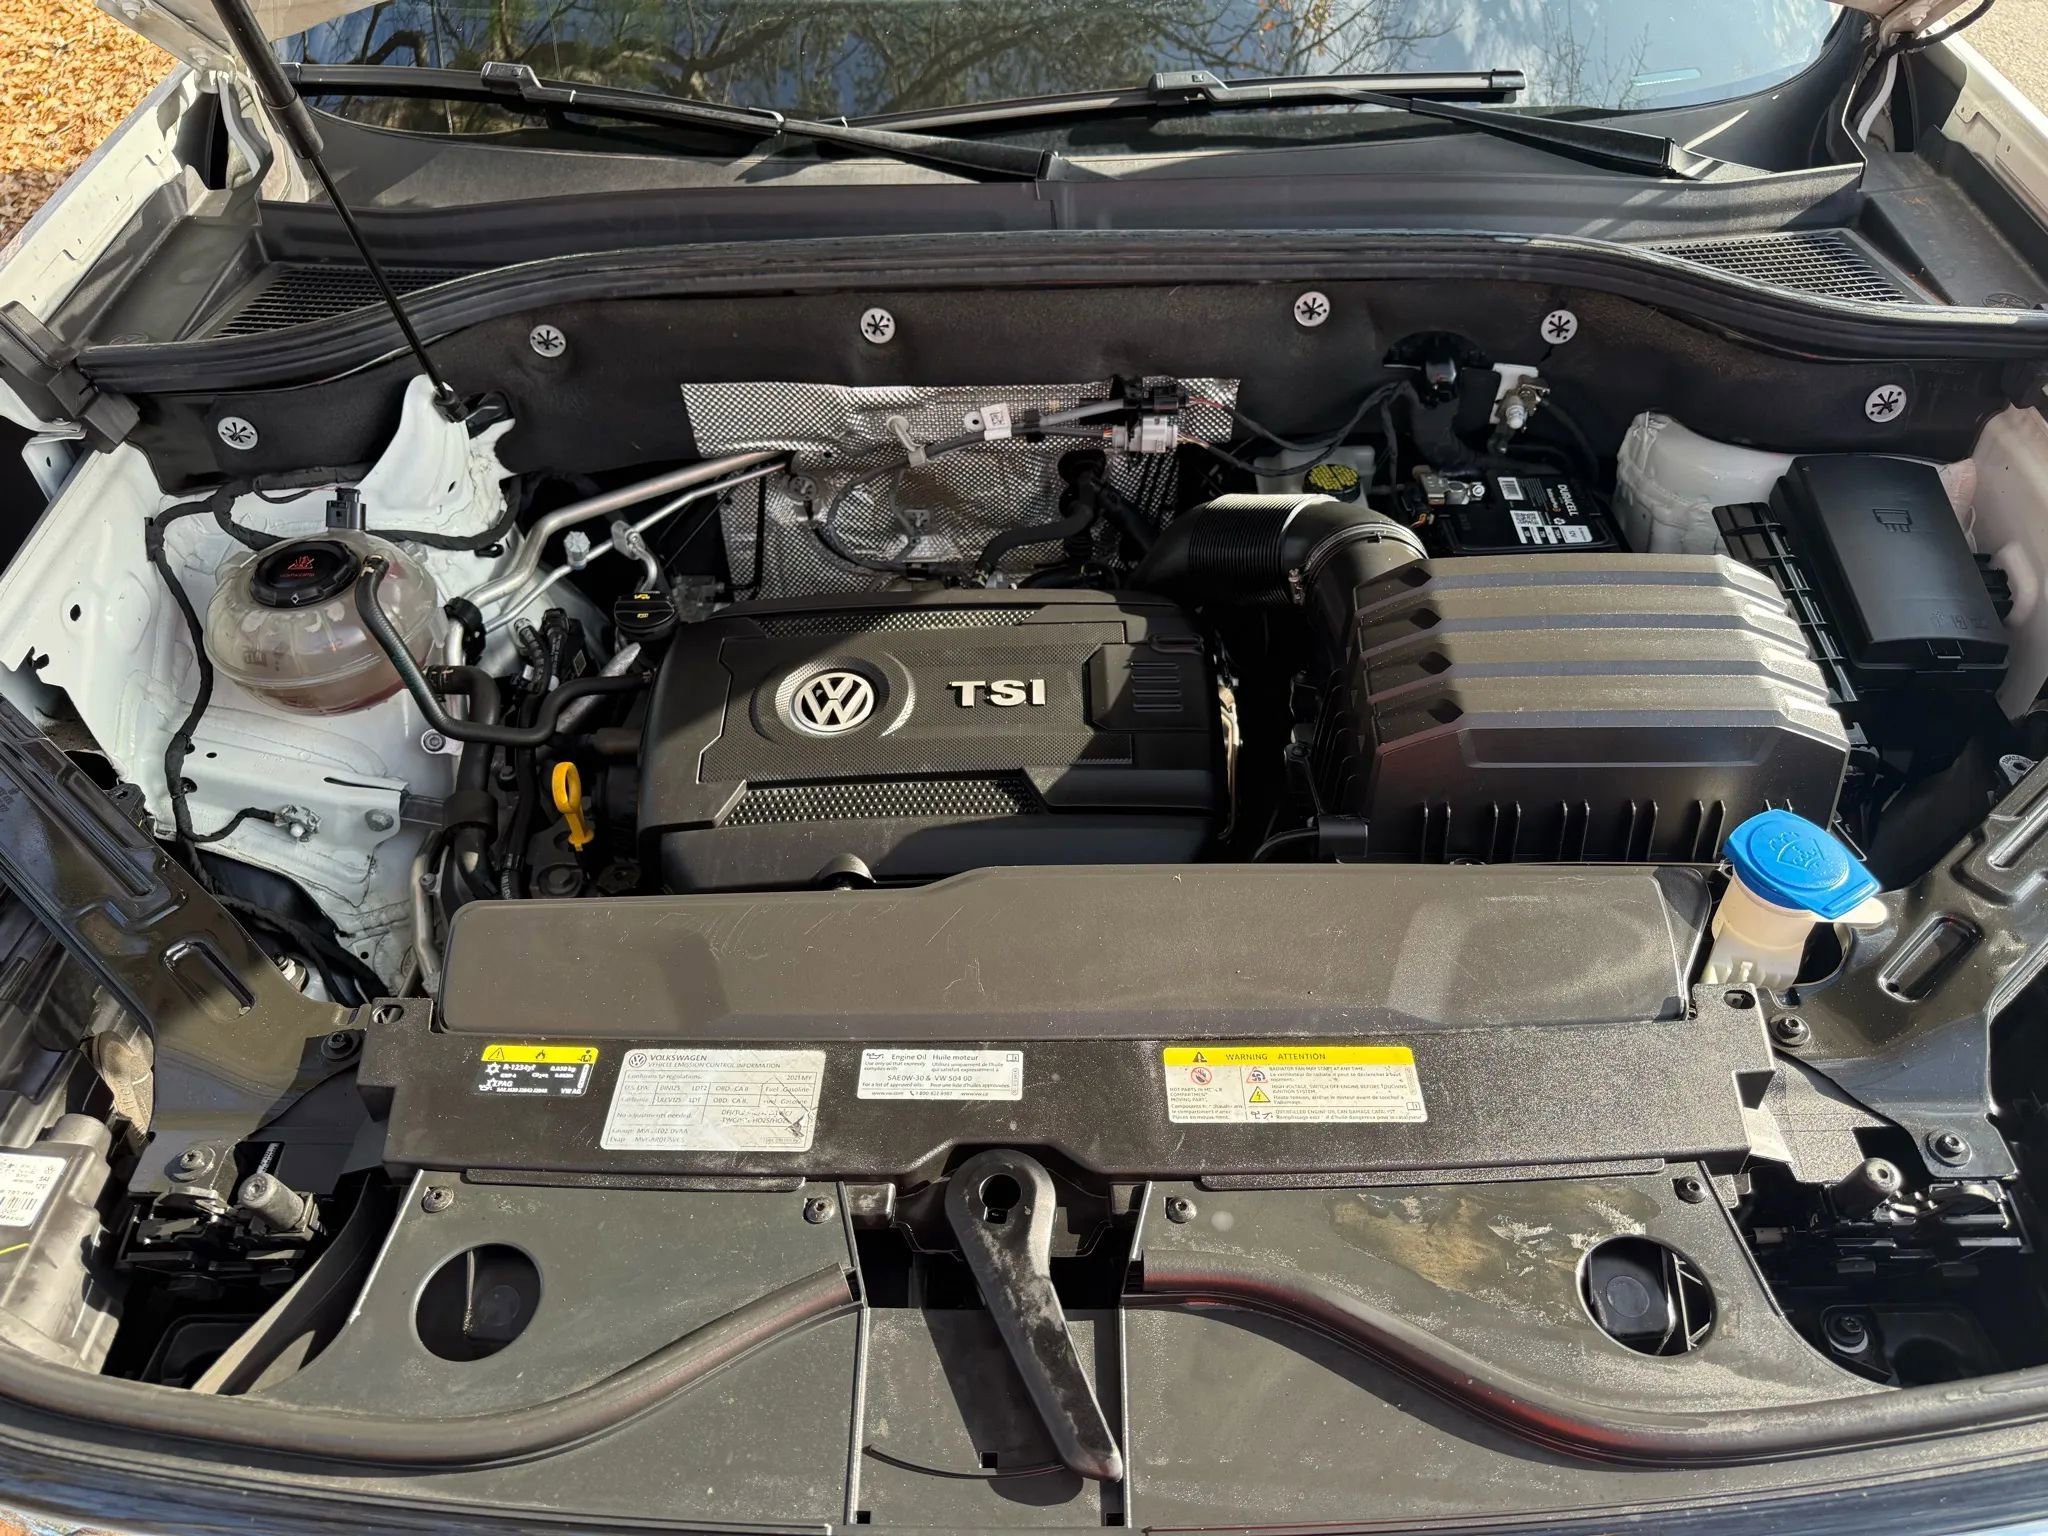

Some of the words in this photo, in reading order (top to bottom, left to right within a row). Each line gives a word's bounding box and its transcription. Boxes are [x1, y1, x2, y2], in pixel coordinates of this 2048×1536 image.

[1558, 484, 1579, 516] DURACELL
[797, 674, 873, 729] VW
[950, 679, 1046, 707] TSI
[892, 1054, 916, 1062] Engine
[1278, 1052, 1326, 1060] ATTENTION
[502, 1064, 536, 1072] R-1234yf
